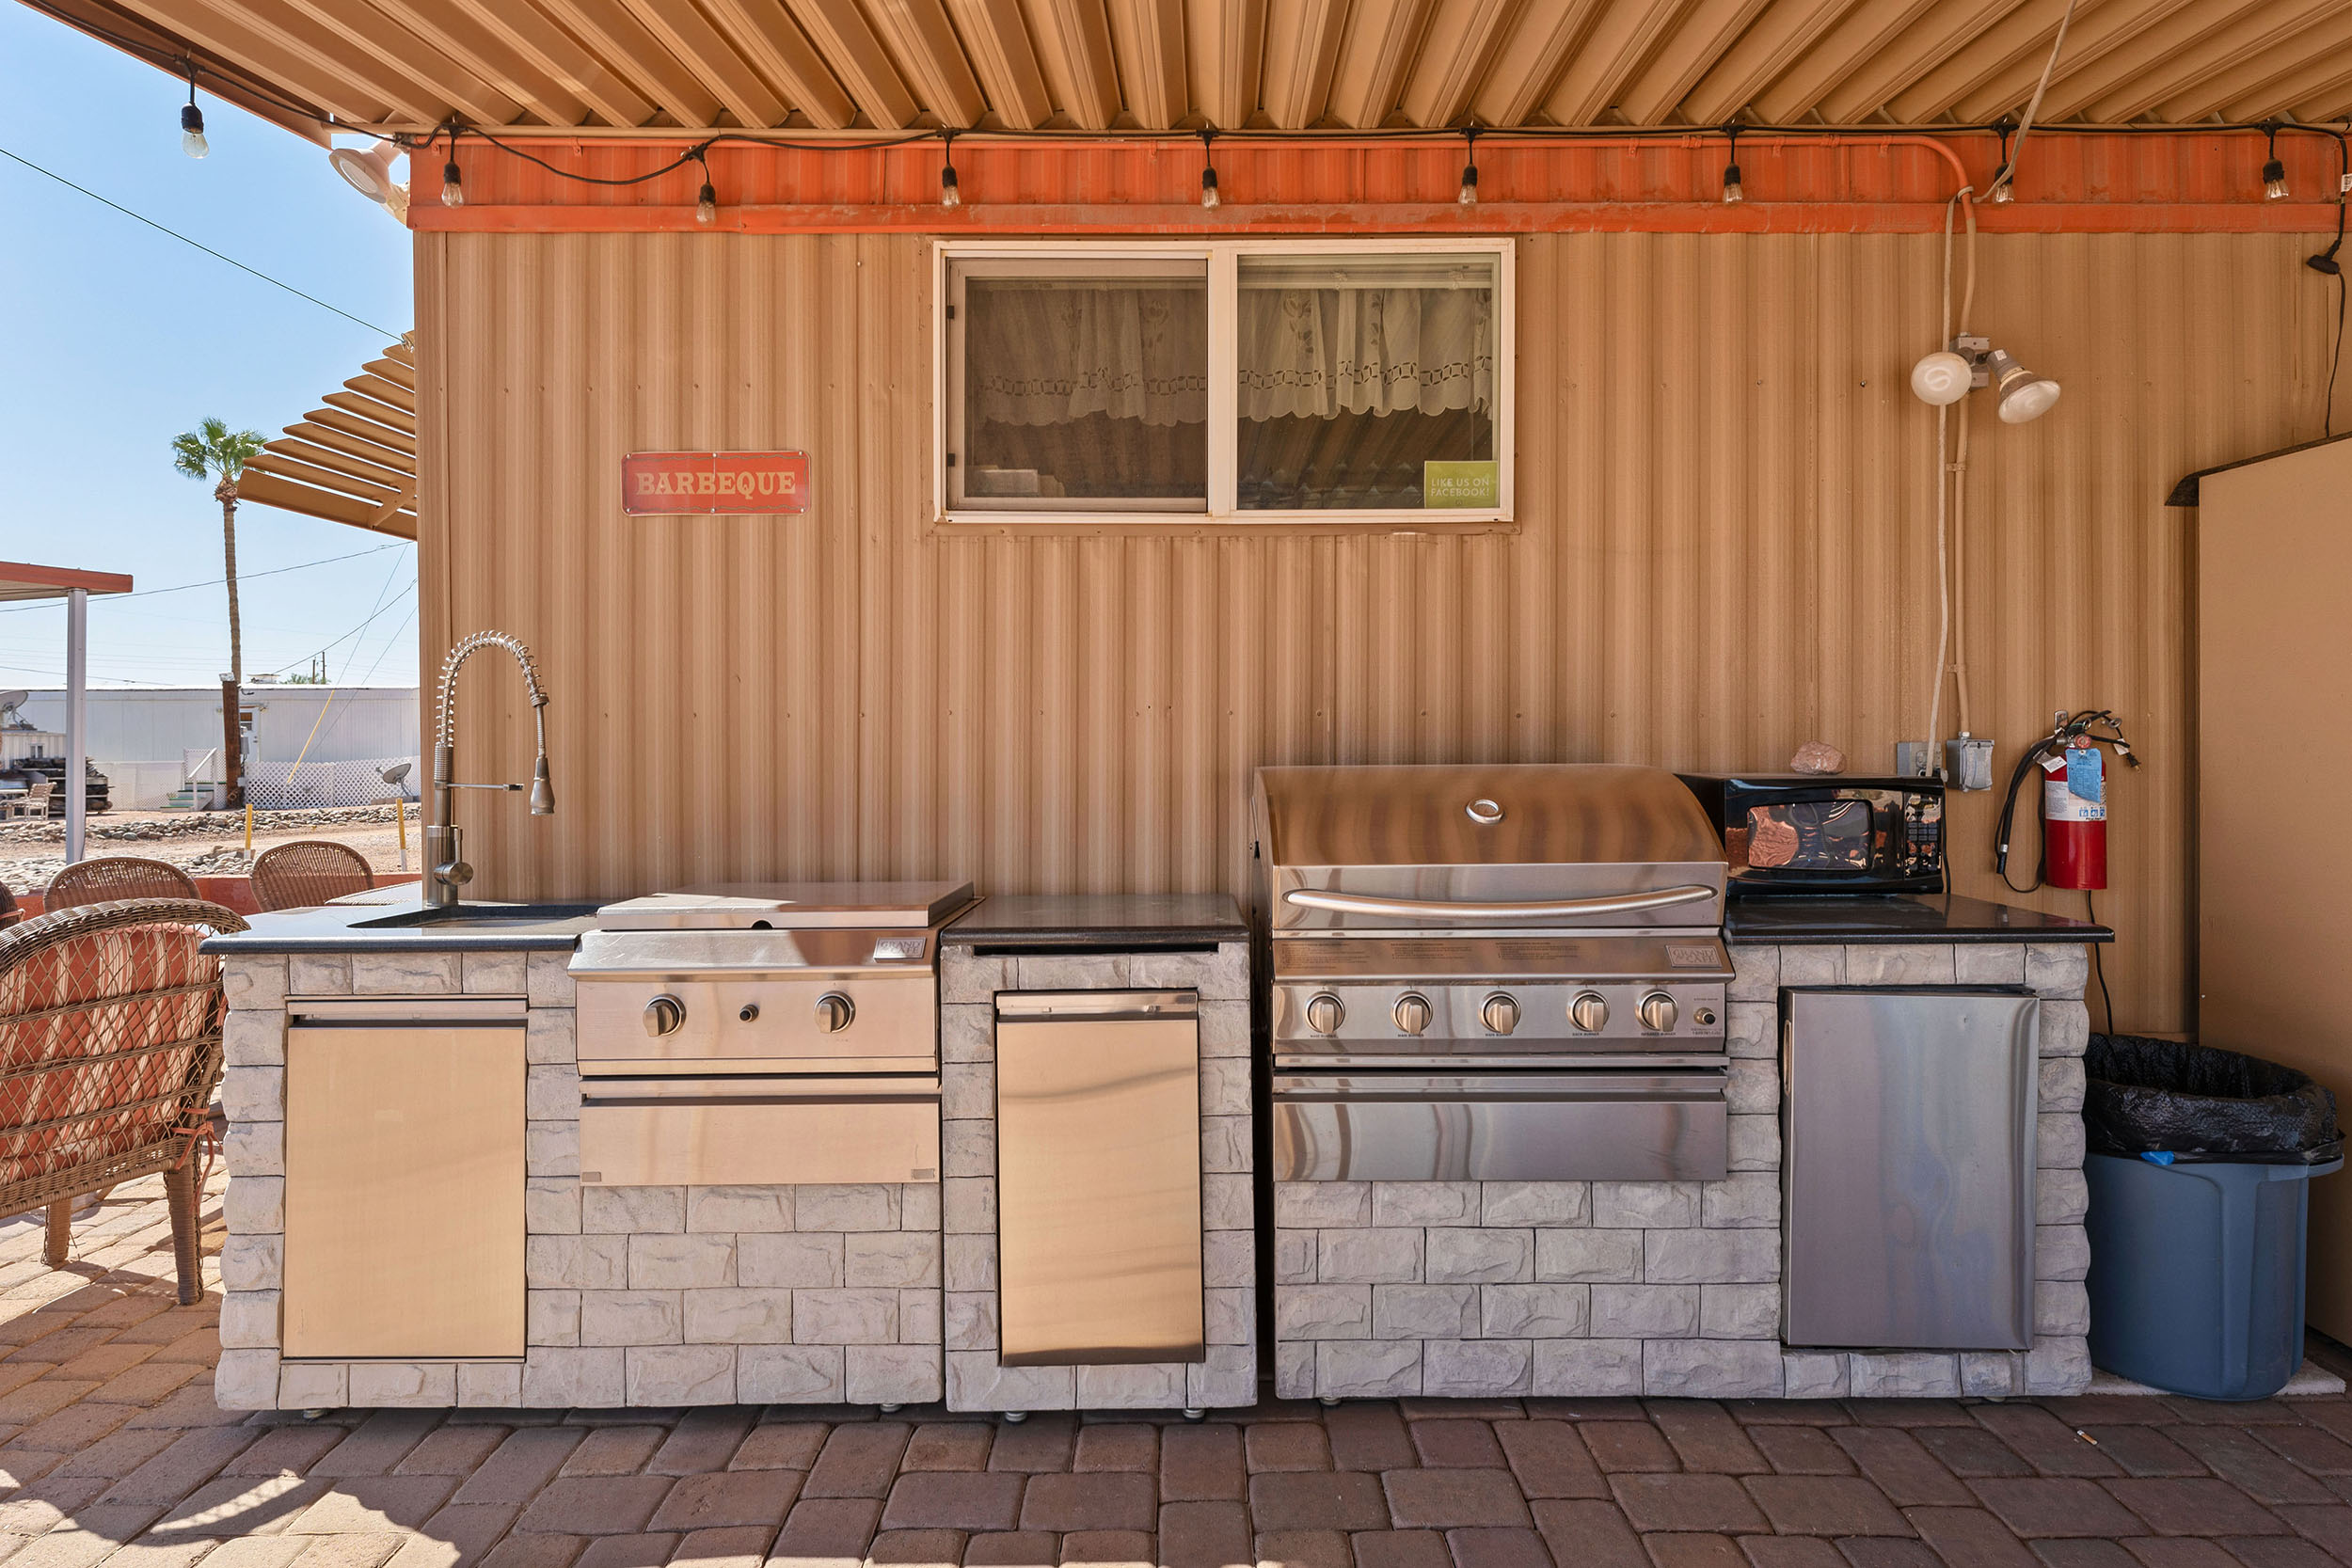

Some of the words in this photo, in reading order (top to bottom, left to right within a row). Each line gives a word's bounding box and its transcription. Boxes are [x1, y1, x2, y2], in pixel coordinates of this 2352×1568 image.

[635, 471, 796, 500] BARBEQUE
[1431, 478, 1454, 487] LIKE
[1456, 478, 1470, 487] US
[1472, 478, 1489, 487] ON
[1431, 487, 1489, 498] FACEBOOK!
[881, 941, 921, 949] GRAND
[1673, 948, 1717, 958] GRAND
